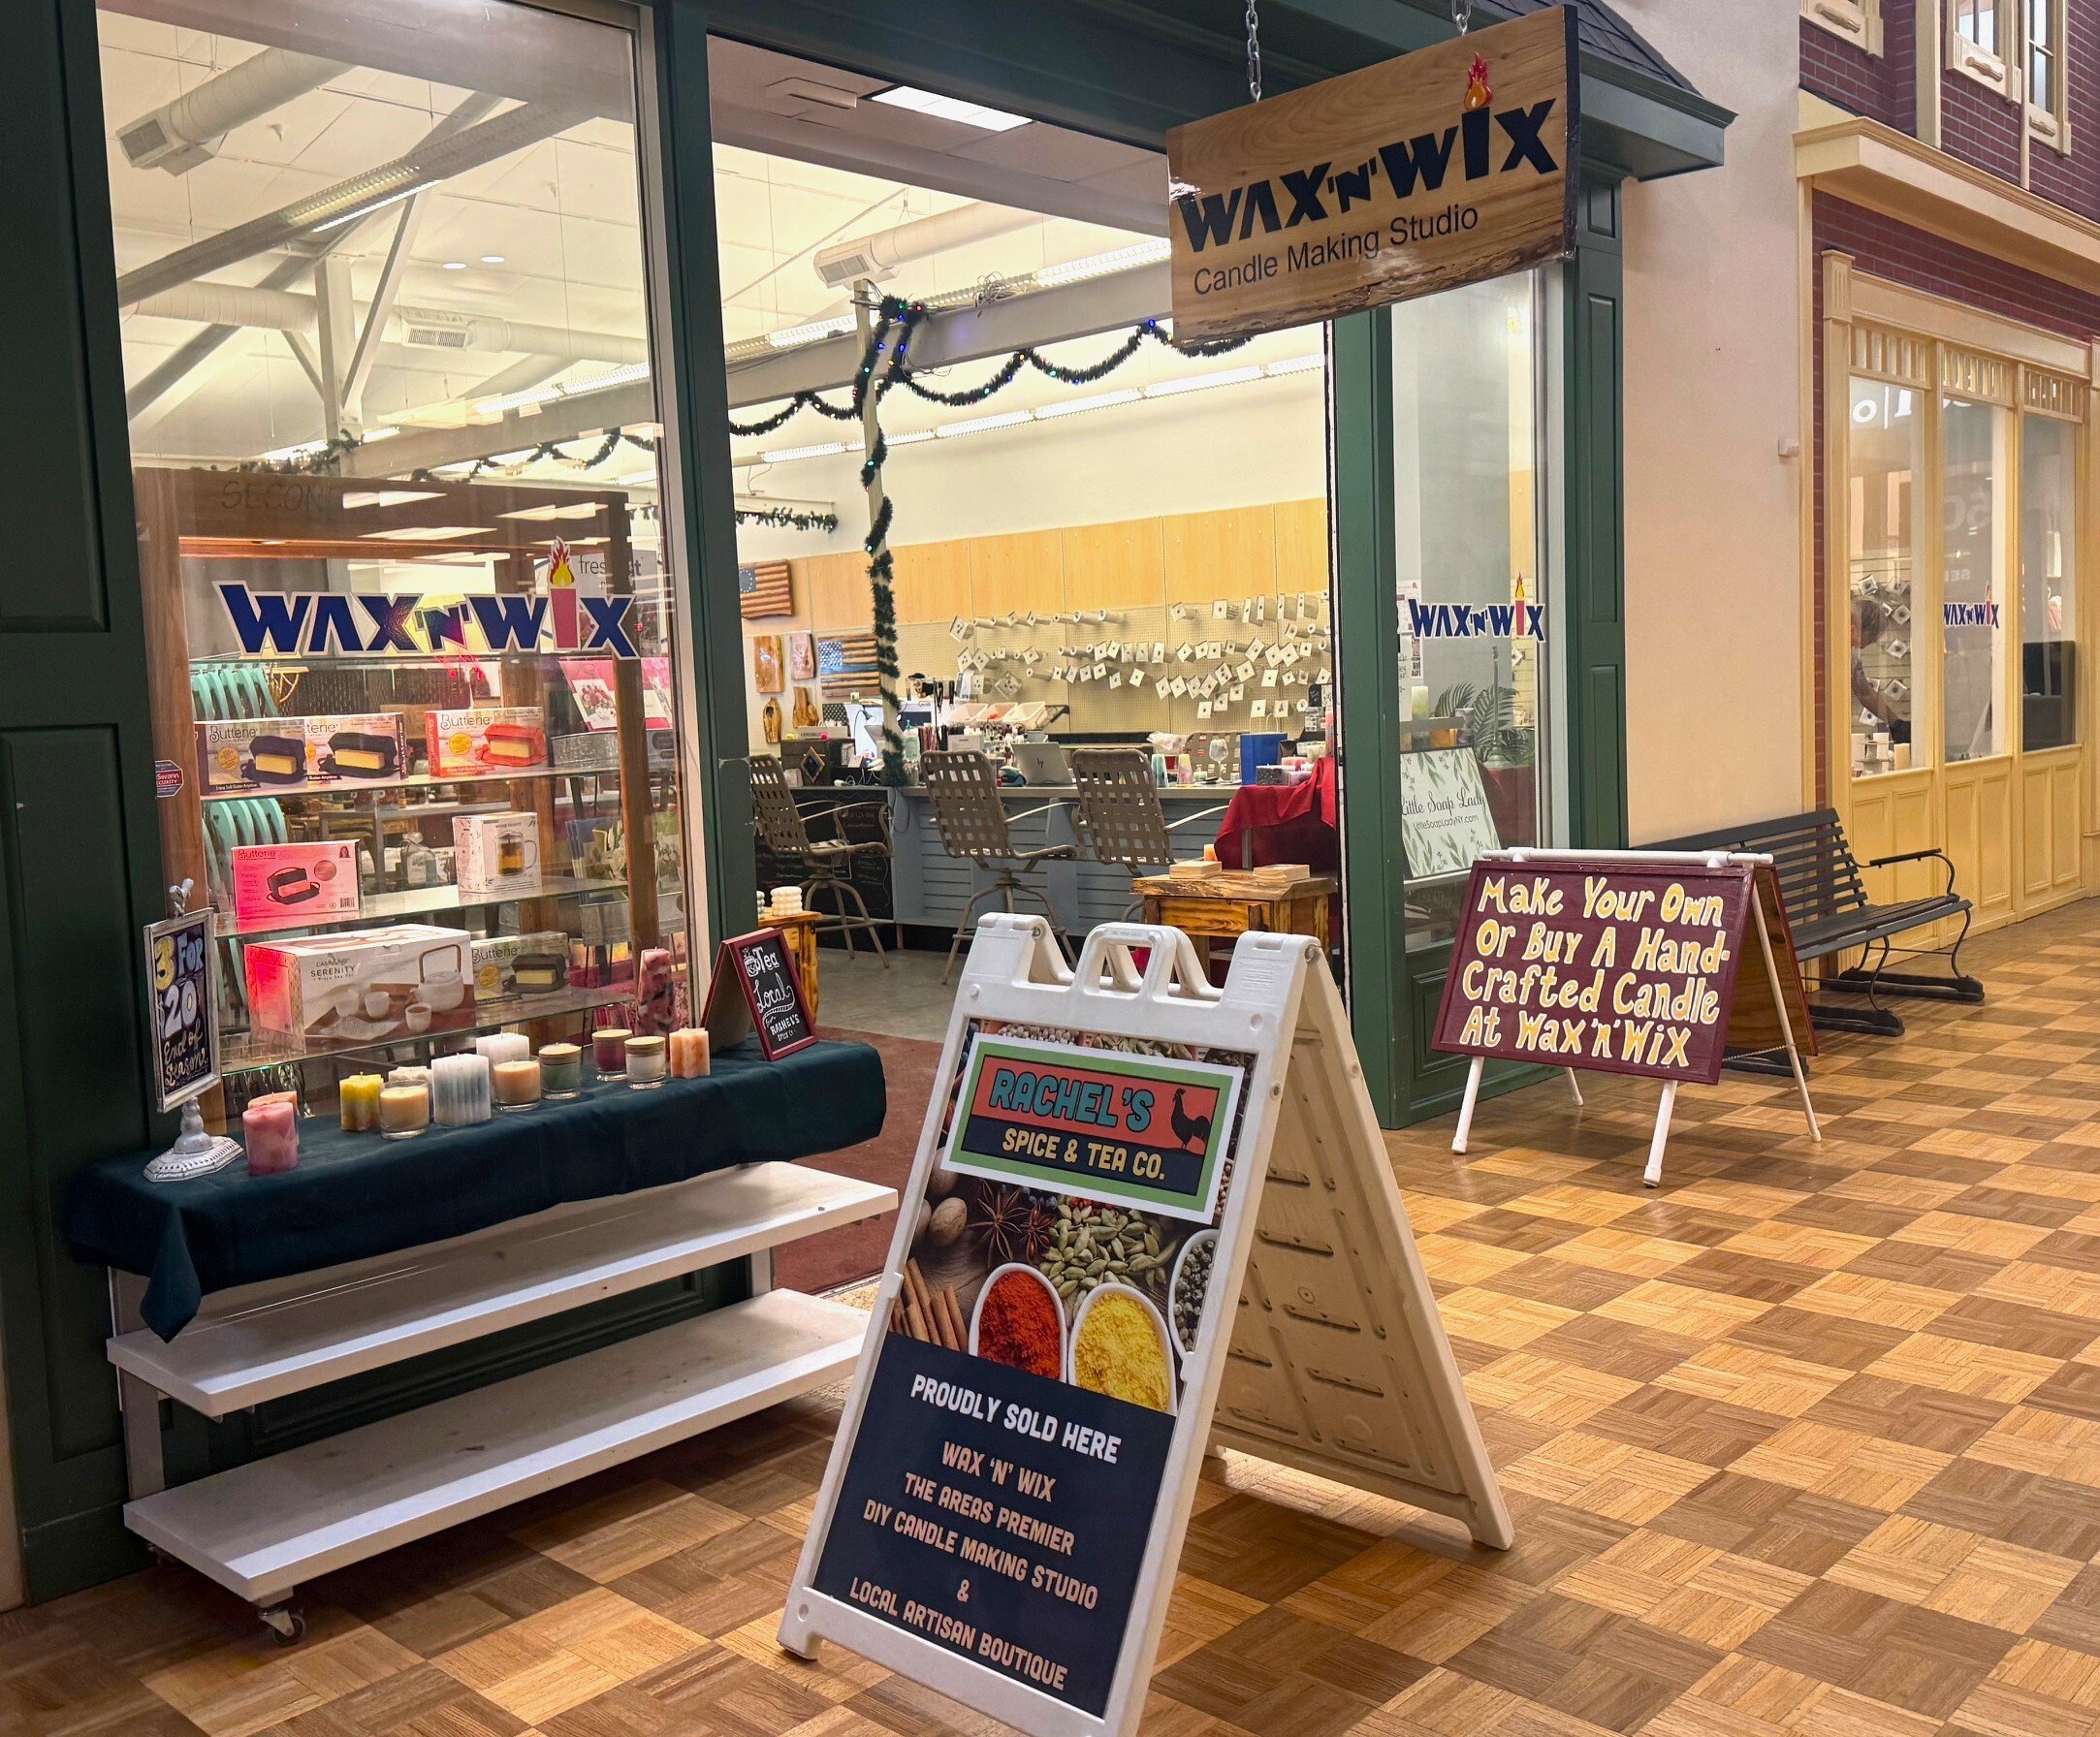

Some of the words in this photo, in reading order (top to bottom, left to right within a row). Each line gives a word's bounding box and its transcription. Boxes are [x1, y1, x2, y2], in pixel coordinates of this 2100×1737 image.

[1193, 254, 1279, 295] Candle
[1288, 231, 1380, 273] Making
[1389, 204, 1479, 246] Studio
[1427, 789, 1454, 816] Soap
[1456, 786, 1486, 811] Lady
[1478, 876, 1564, 916] Make
[1583, 876, 1655, 922] Your
[1660, 883, 1724, 927] Own
[154, 936, 175, 990] 3
[177, 932, 204, 977] FOR
[311, 965, 355, 978] SERENITY
[752, 946, 780, 973] Tea
[1477, 919, 1516, 957] Or
[1591, 927, 1616, 967] A
[1632, 927, 1731, 974] Hand-
[753, 972, 790, 1013] Local
[1462, 960, 1605, 1012] Crafted
[1613, 972, 1720, 1025] Candle
[164, 1030, 186, 1065] End
[1459, 1005, 1502, 1047] At
[988, 1068, 1155, 1132] RACHEL'S
[1002, 1127, 1060, 1160] SPICE
[1064, 1139, 1078, 1163] &
[1088, 1142, 1127, 1173] TEA
[1132, 1153, 1164, 1181] CO.
[909, 1374, 1002, 1424] PROUDLY
[1003, 1404, 1059, 1442] SOLD
[1062, 1422, 1122, 1464] HERE
[941, 1441, 985, 1477] WAX
[1017, 1467, 1057, 1502] WIX
[905, 1472, 937, 1501] THE
[938, 1485, 993, 1525] AREAS
[996, 1507, 1075, 1556] PREMIER
[863, 1499, 892, 1527] DIY
[894, 1511, 958, 1553] CANDLE
[959, 1536, 1029, 1582] MAKING
[1031, 1564, 1098, 1611] STUDIO
[956, 1579, 970, 1602] &
[849, 1576, 898, 1616] LOCAL
[903, 1598, 975, 1650] ARTISAN
[978, 1632, 1068, 1691] BOUTIQUE
